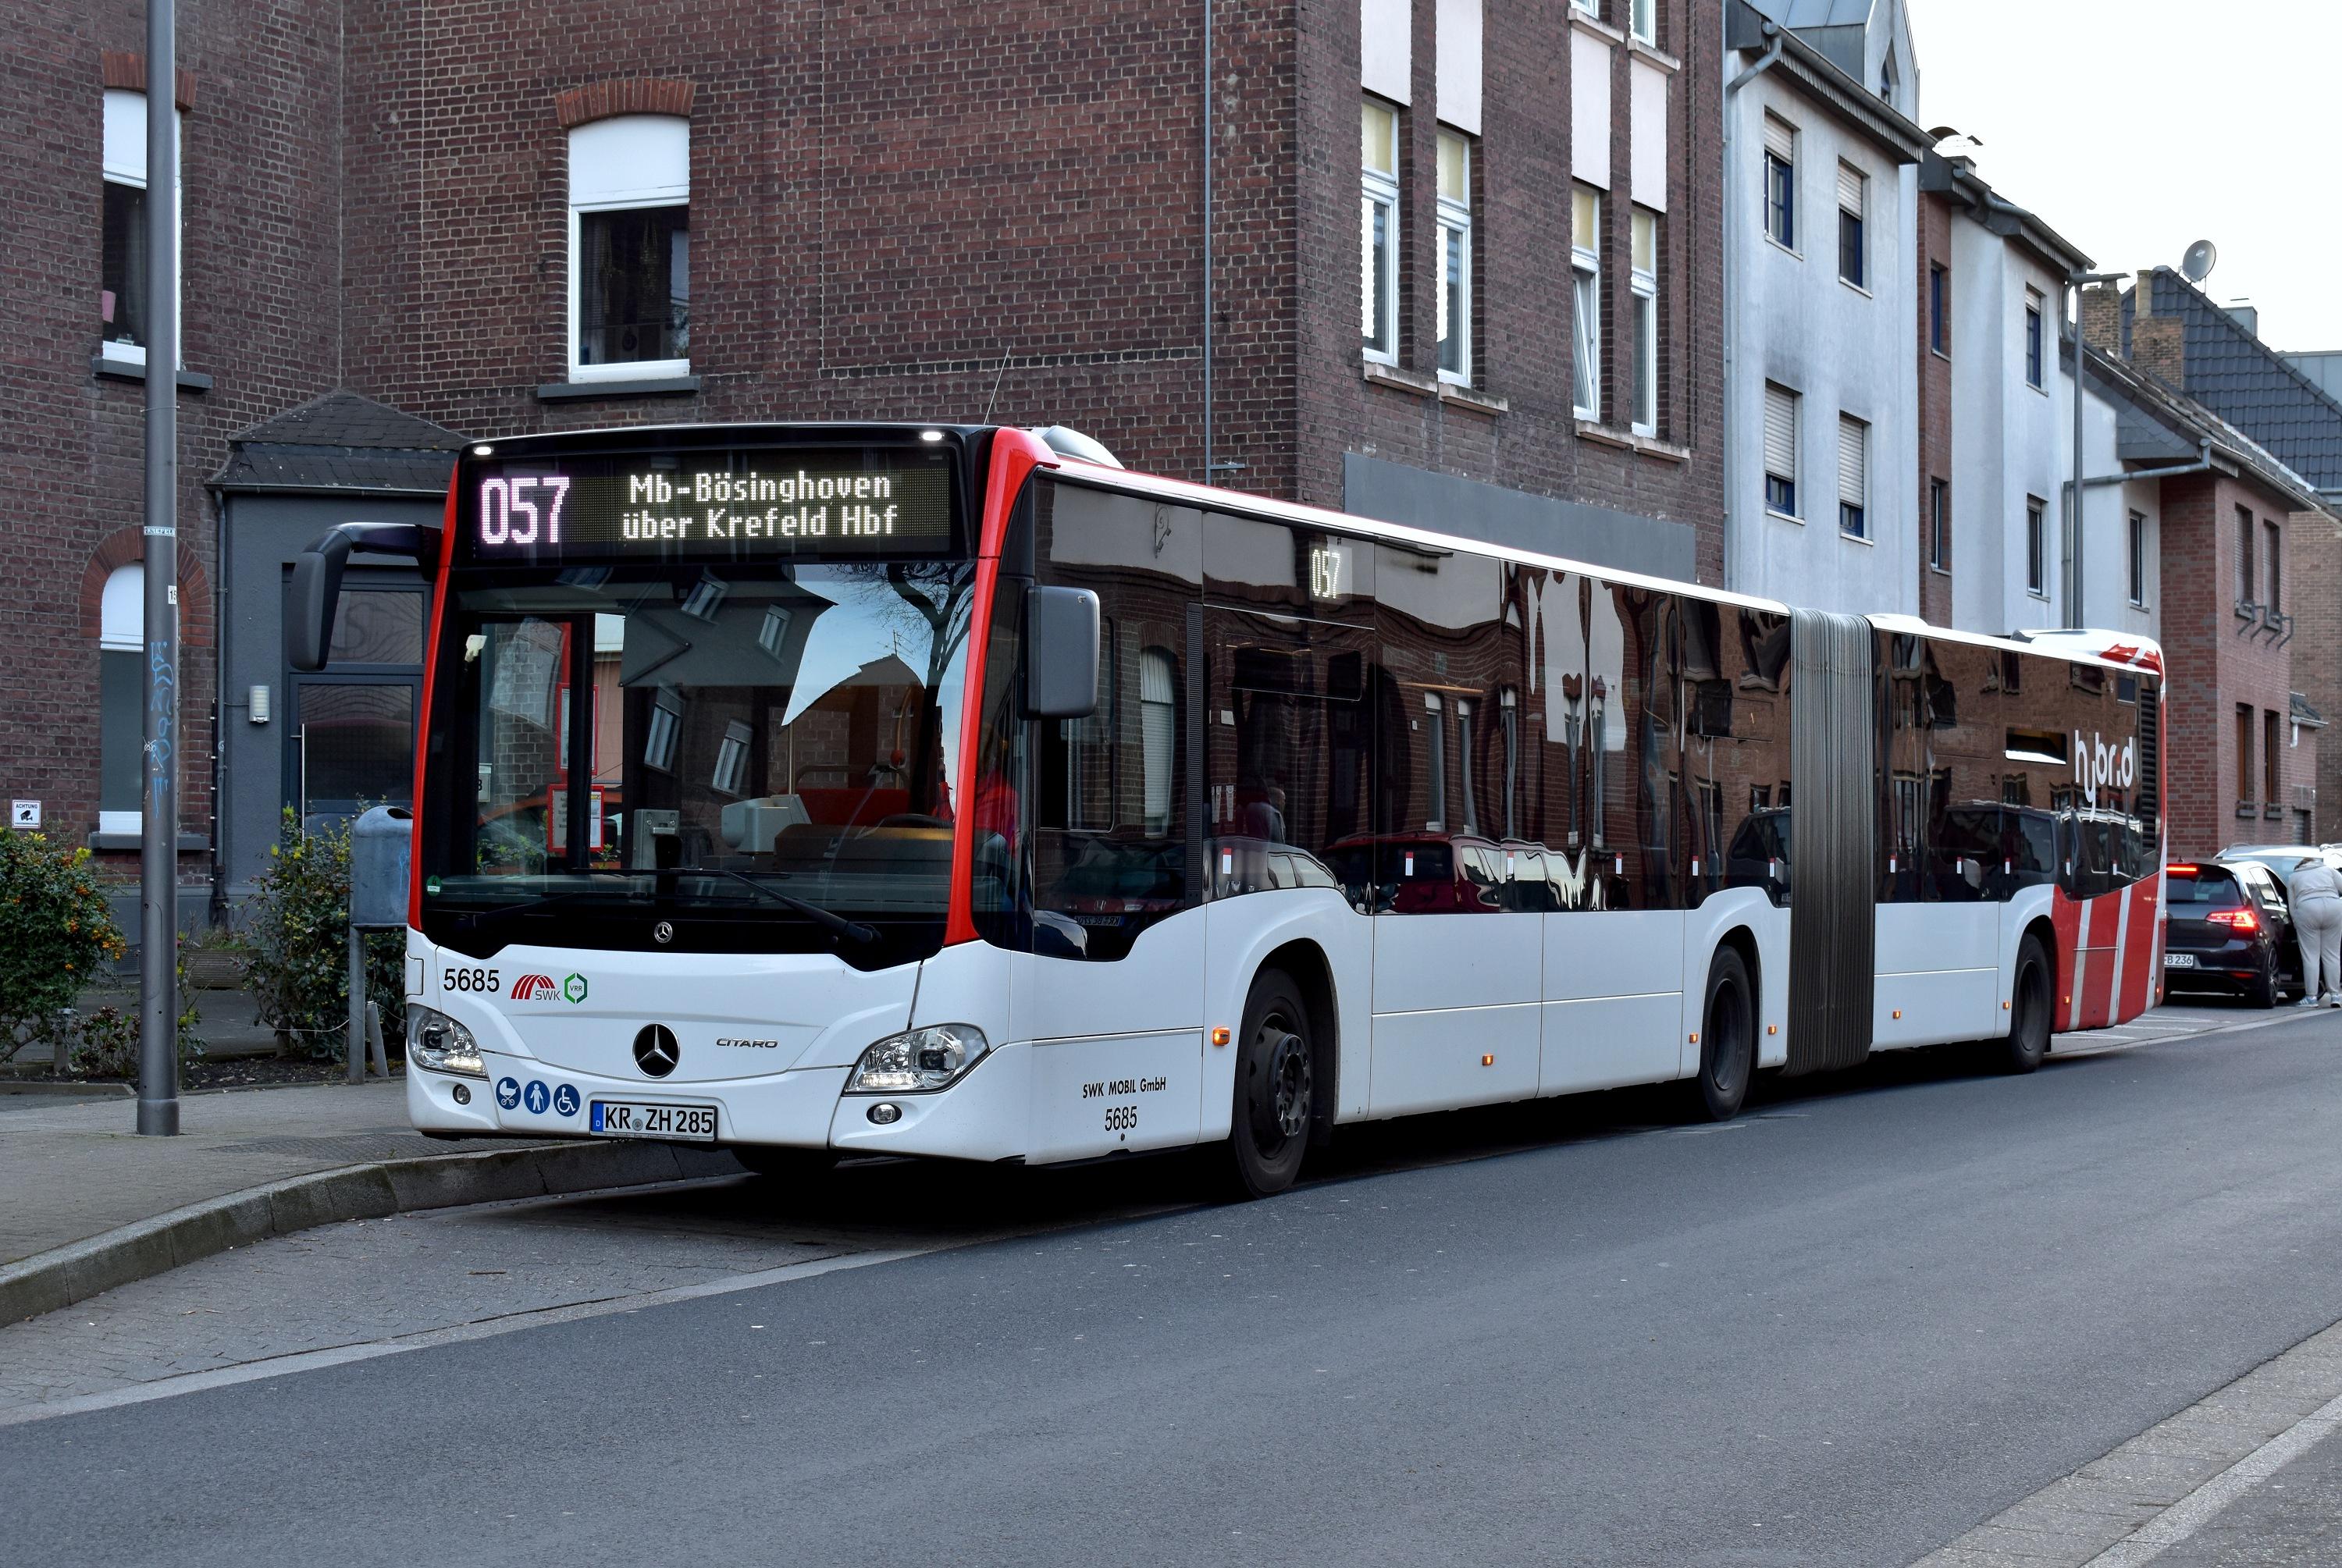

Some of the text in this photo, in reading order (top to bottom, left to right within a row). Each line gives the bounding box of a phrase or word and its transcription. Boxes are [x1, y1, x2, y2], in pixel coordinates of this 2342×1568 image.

[630, 470, 891, 503] Mb-Bösinghoven
[482, 476, 570, 544] 057
[623, 504, 898, 539] über Krefeld Hbf
[1312, 549, 1340, 599] 057
[2074, 729, 2134, 823] hybrid
[2175, 955, 2192, 965] 236
[443, 968, 500, 992] 5685
[535, 990, 561, 1001] SWK
[716, 1037, 778, 1048] CITARO
[1082, 1076, 1166, 1099] SWK MOBIL GmbH
[605, 1107, 631, 1129] KR
[645, 1108, 671, 1132] ZH
[675, 1111, 714, 1134] 285
[1105, 1105, 1137, 1132] 5685
